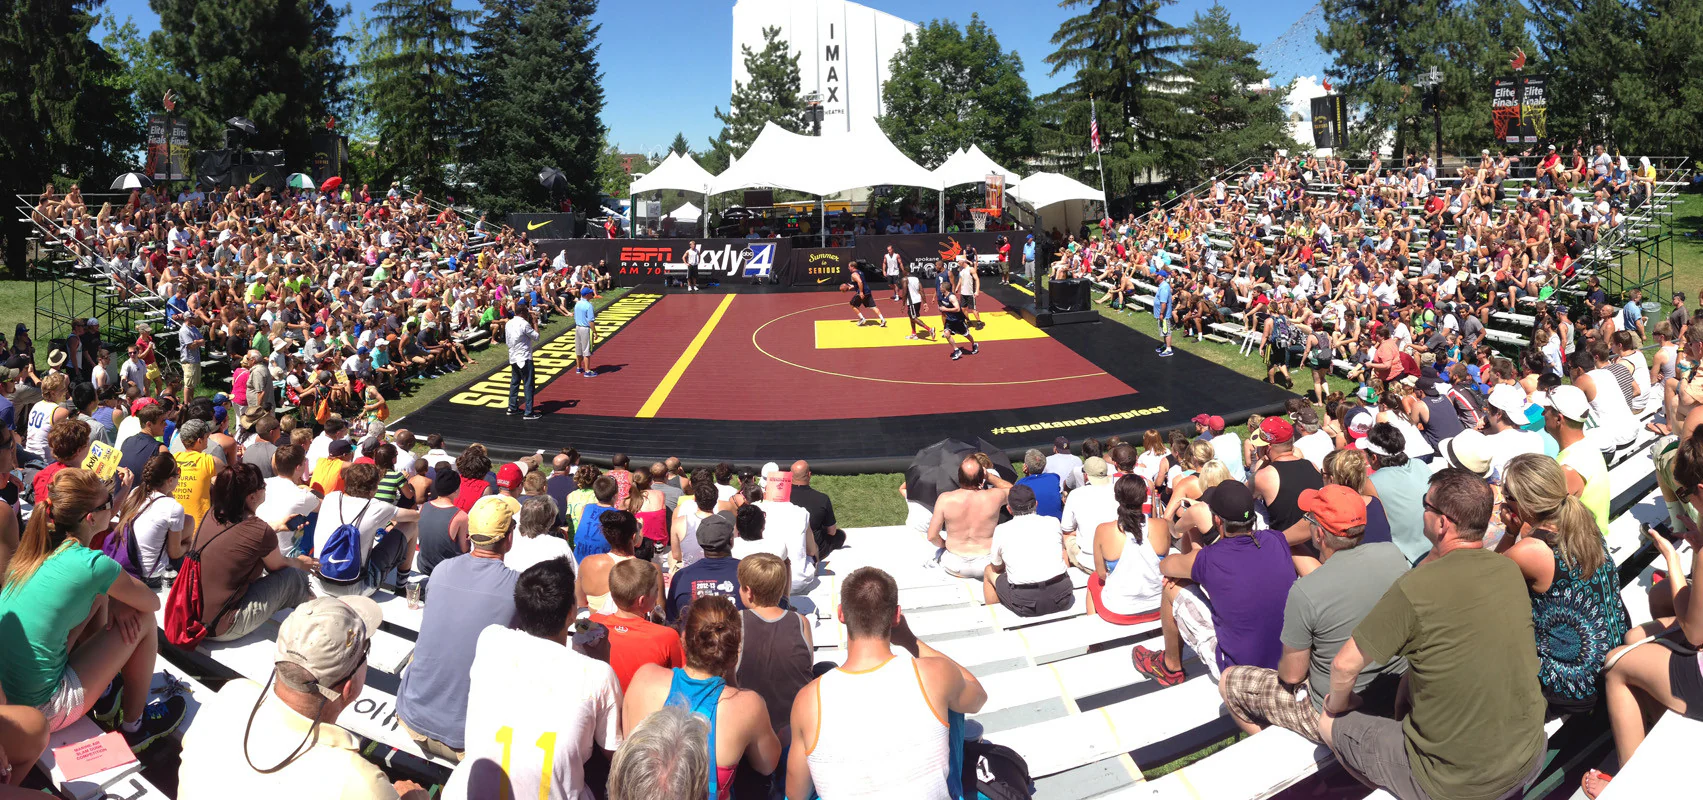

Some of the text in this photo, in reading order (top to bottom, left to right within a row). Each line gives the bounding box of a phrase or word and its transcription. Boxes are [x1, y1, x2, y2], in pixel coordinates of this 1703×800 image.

[826, 23, 839, 103] IMAX
[1495, 88, 1516, 98] Elite
[1524, 86, 1544, 96] Elite
[1492, 97, 1519, 107] Finals
[1522, 96, 1547, 106] Finals
[150, 125, 165, 135] Elite
[172, 127, 187, 136] Elite
[148, 135, 167, 144] Finals
[620, 247, 672, 262] ESPN
[742, 249, 754, 259] abc
[808, 253, 840, 263] Summer
[745, 243, 773, 276] 4
[620, 267, 639, 275] AM
[808, 266, 841, 275] SERIOUS
[29, 410, 45, 429] 30
[991, 405, 1170, 435] #spokanehoopfest
[76, 748, 108, 761] COMPETITION
[495, 725, 557, 800] 11
